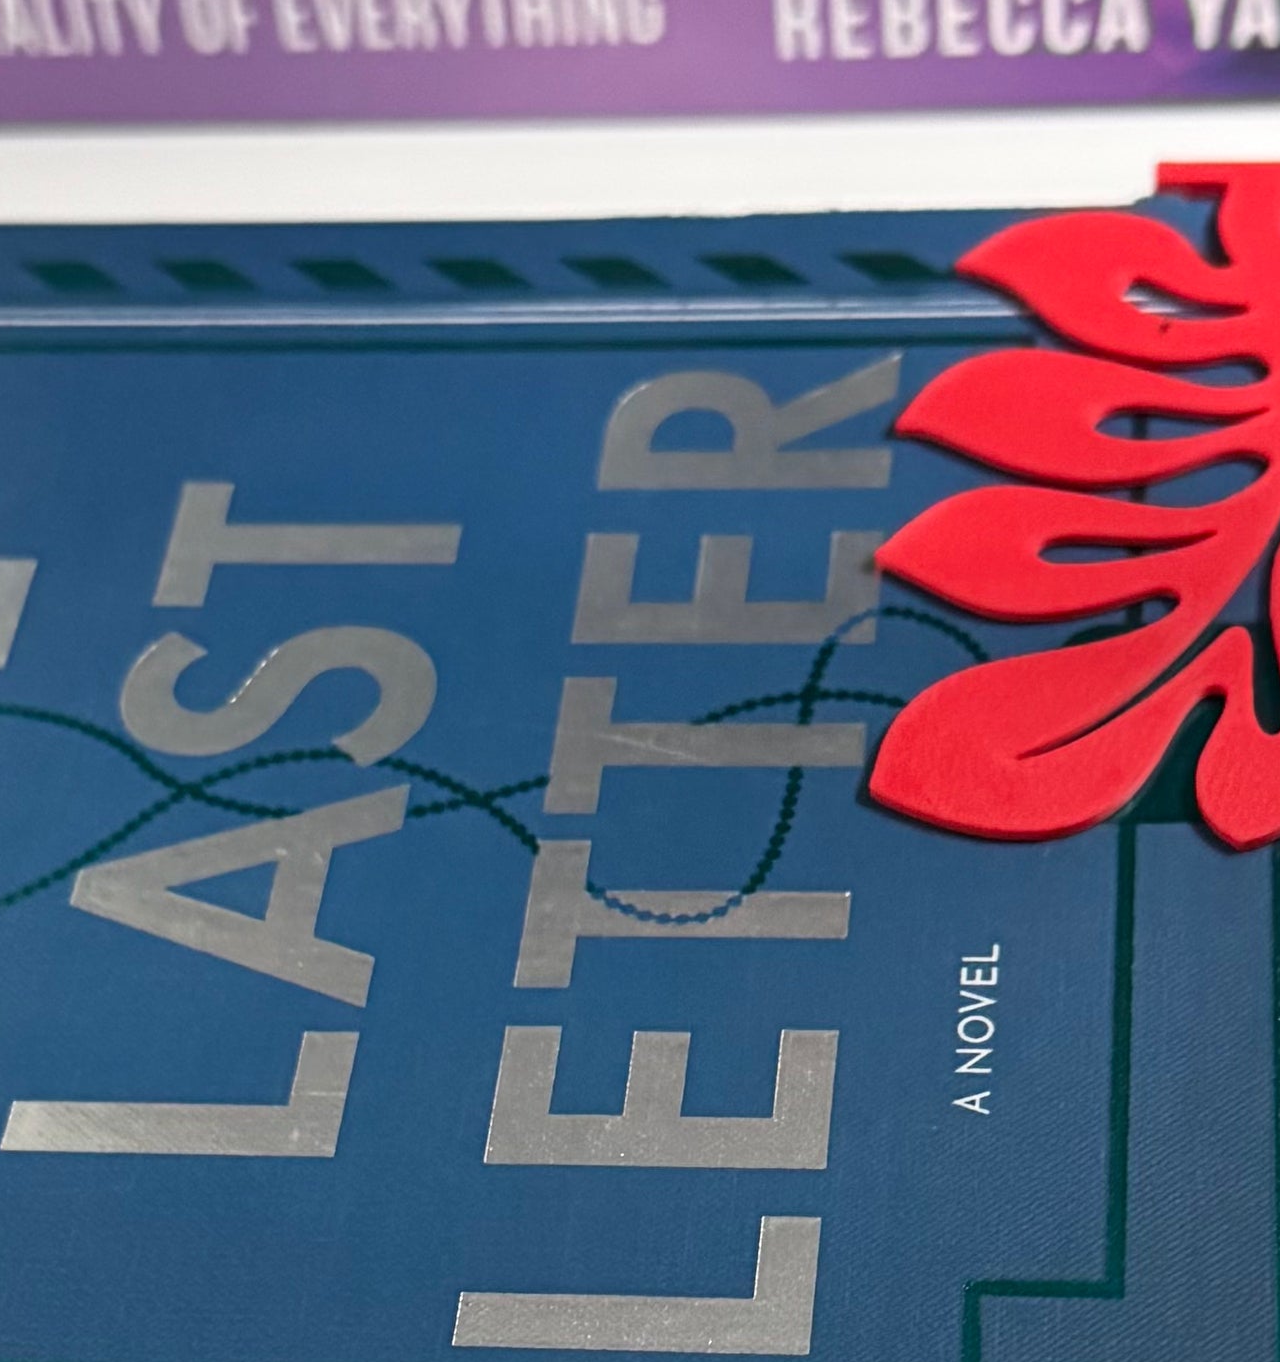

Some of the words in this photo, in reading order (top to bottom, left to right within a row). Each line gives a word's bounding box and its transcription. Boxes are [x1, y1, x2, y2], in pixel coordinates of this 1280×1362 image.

[0, 481, 463, 1158] LAST
[452, 353, 904, 1355] LETTER
[954, 942, 1000, 1074] NOVEL
[951, 1090, 992, 1116] A
